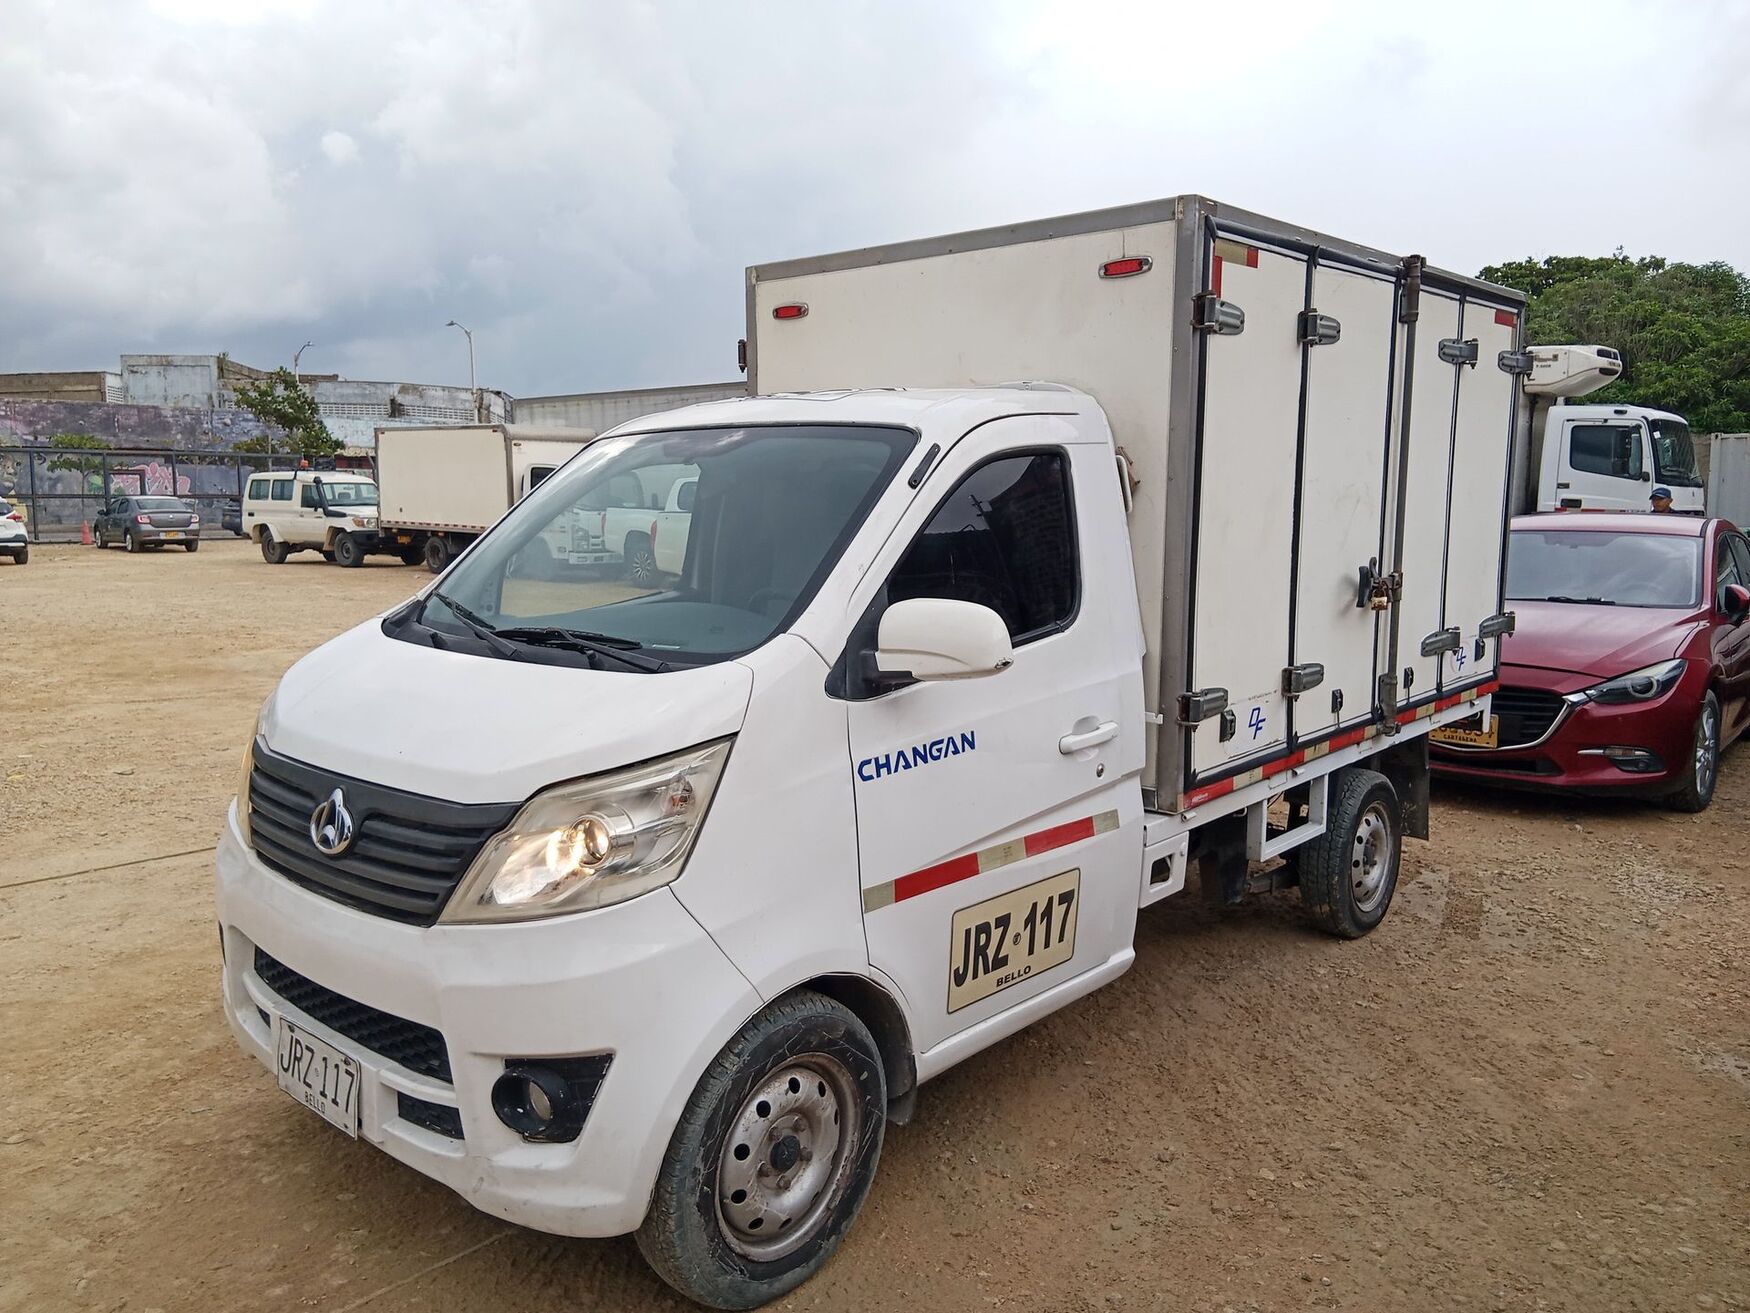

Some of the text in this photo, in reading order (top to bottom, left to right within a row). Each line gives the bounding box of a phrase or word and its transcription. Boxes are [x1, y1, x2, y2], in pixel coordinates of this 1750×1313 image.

[857, 730, 976, 782] CHANGAN
[953, 888, 1076, 987] JRZ 117
[996, 965, 1032, 987] BELLO
[281, 1035, 355, 1114] JRZ 117
[305, 1091, 325, 1114] BELLO
